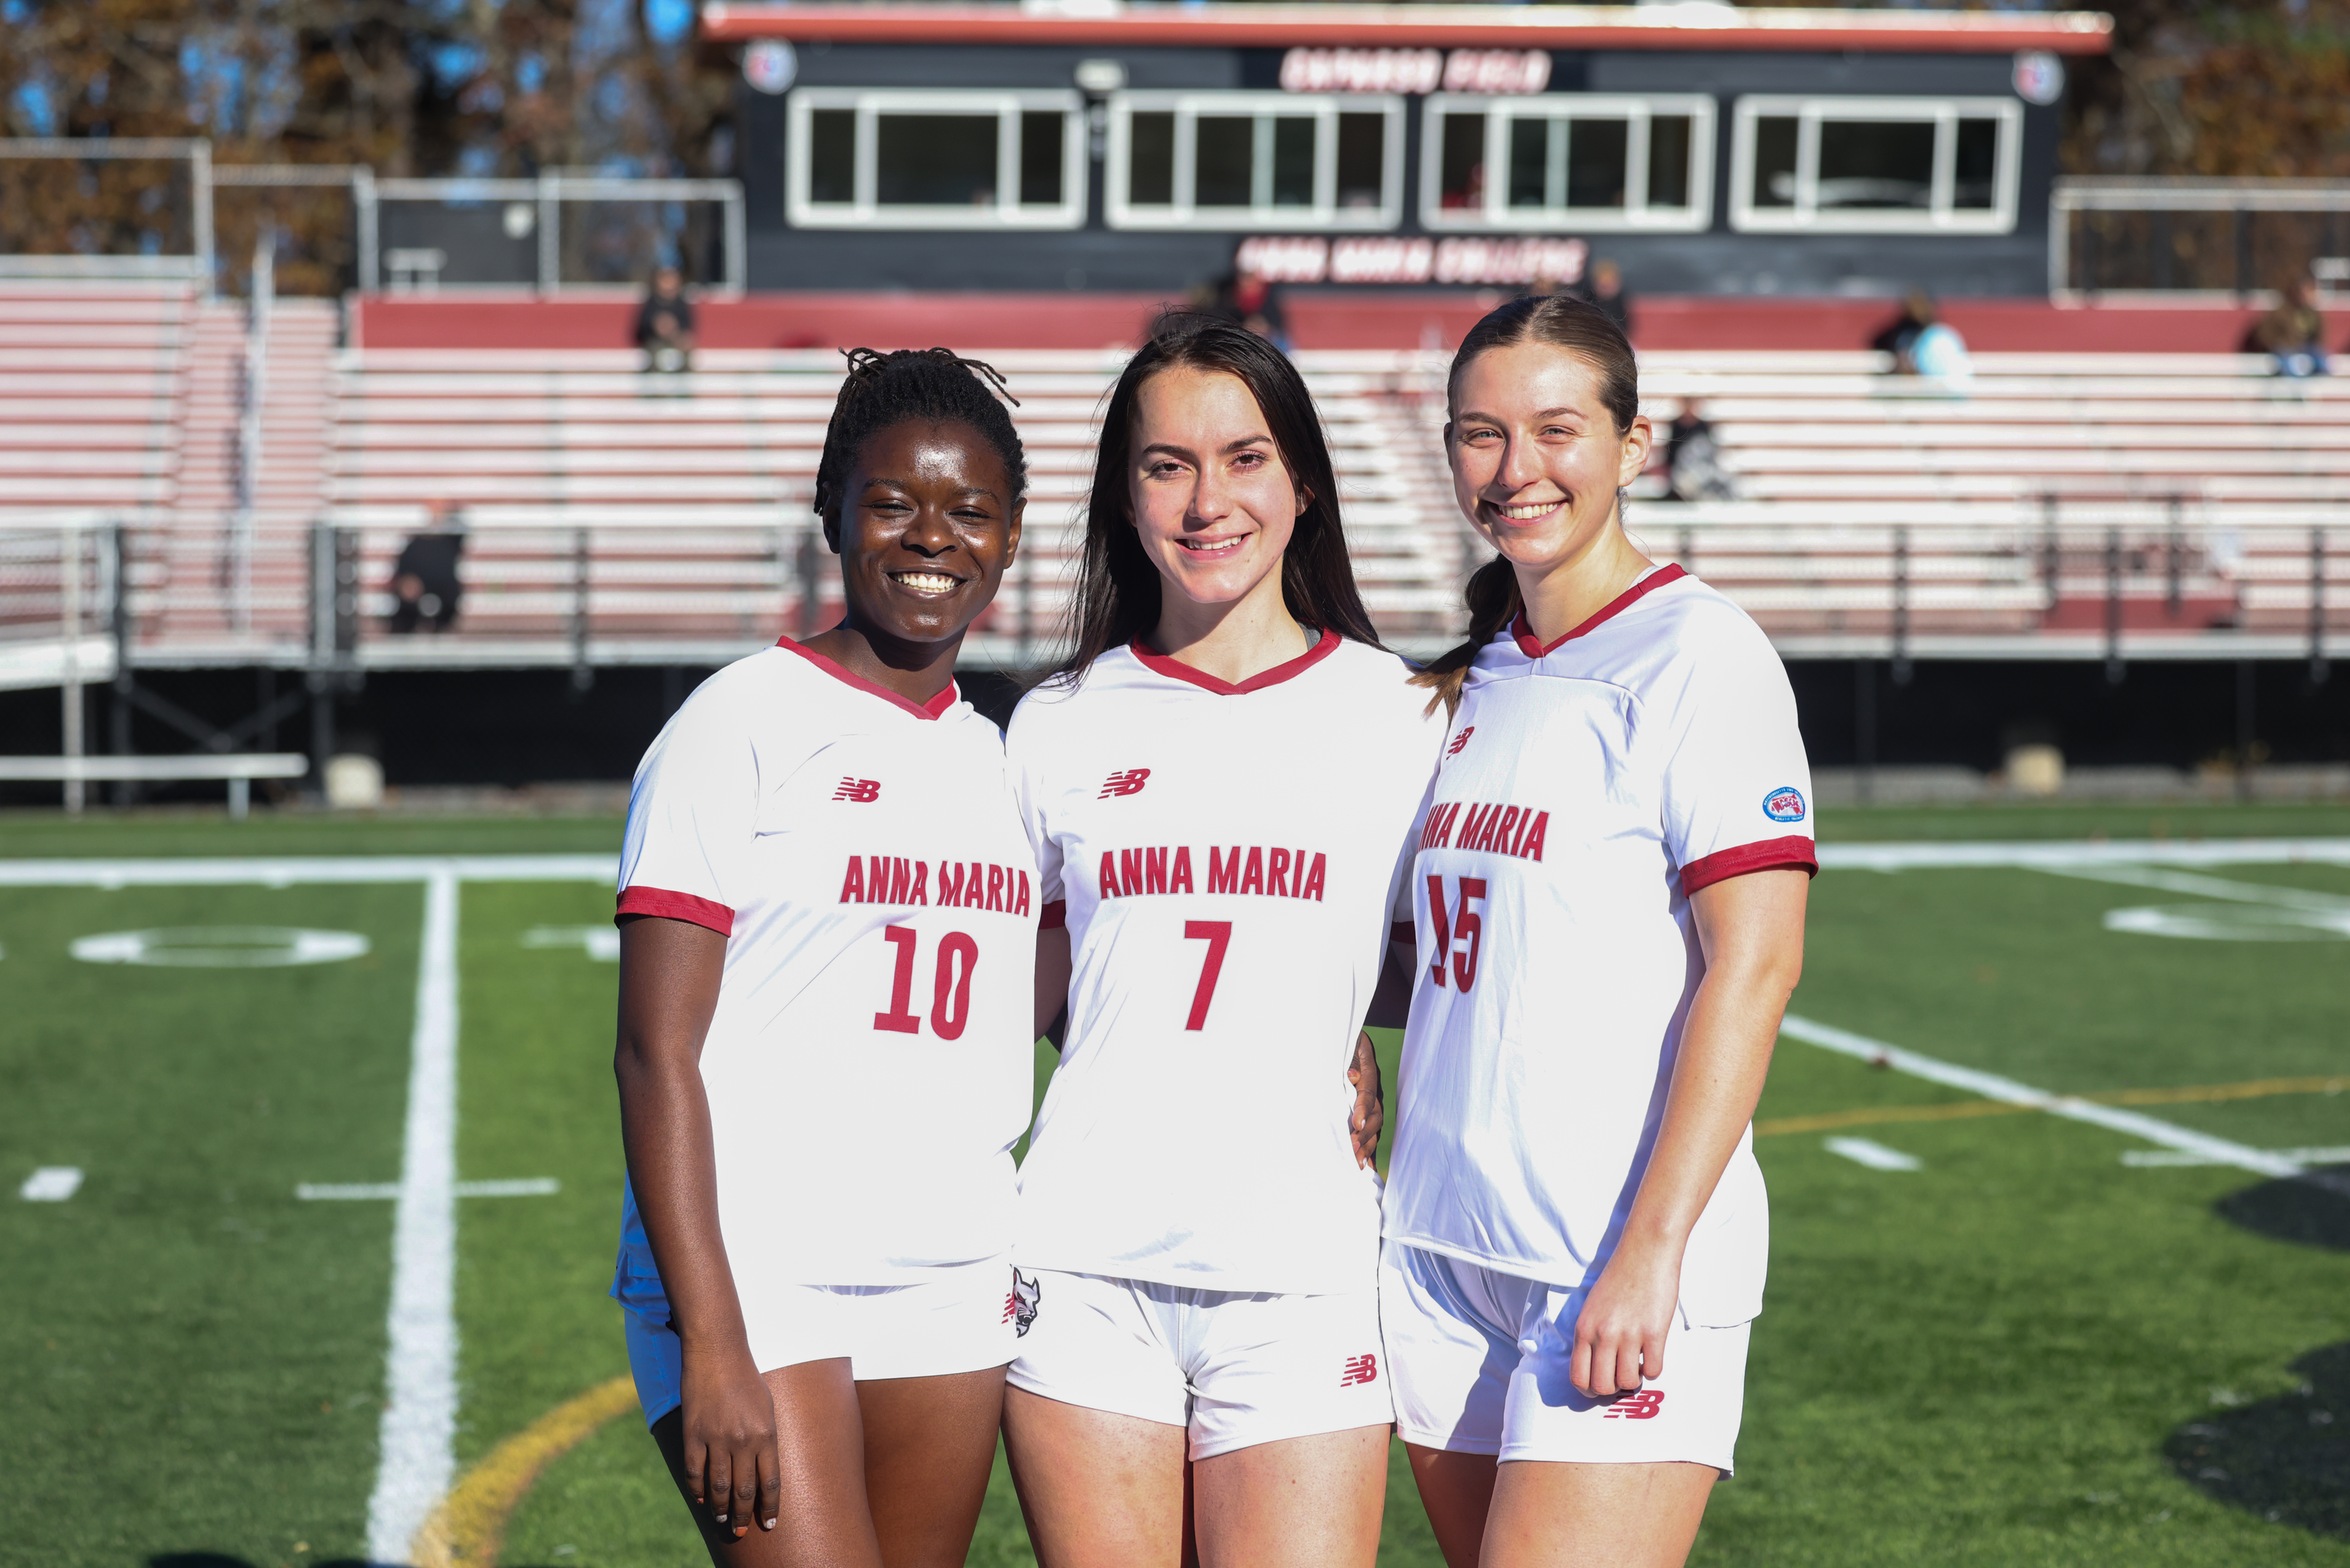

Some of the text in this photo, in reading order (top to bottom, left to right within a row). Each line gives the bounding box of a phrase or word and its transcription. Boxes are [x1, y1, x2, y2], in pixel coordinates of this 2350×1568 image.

[1100, 845, 1327, 903] ANNA MARIA
[1455, 802, 1550, 863] MARIA
[838, 855, 1031, 919] ANNA MARIA
[1184, 920, 1233, 1031] 7
[1426, 874, 1488, 994] 15
[873, 924, 979, 1041] 10
